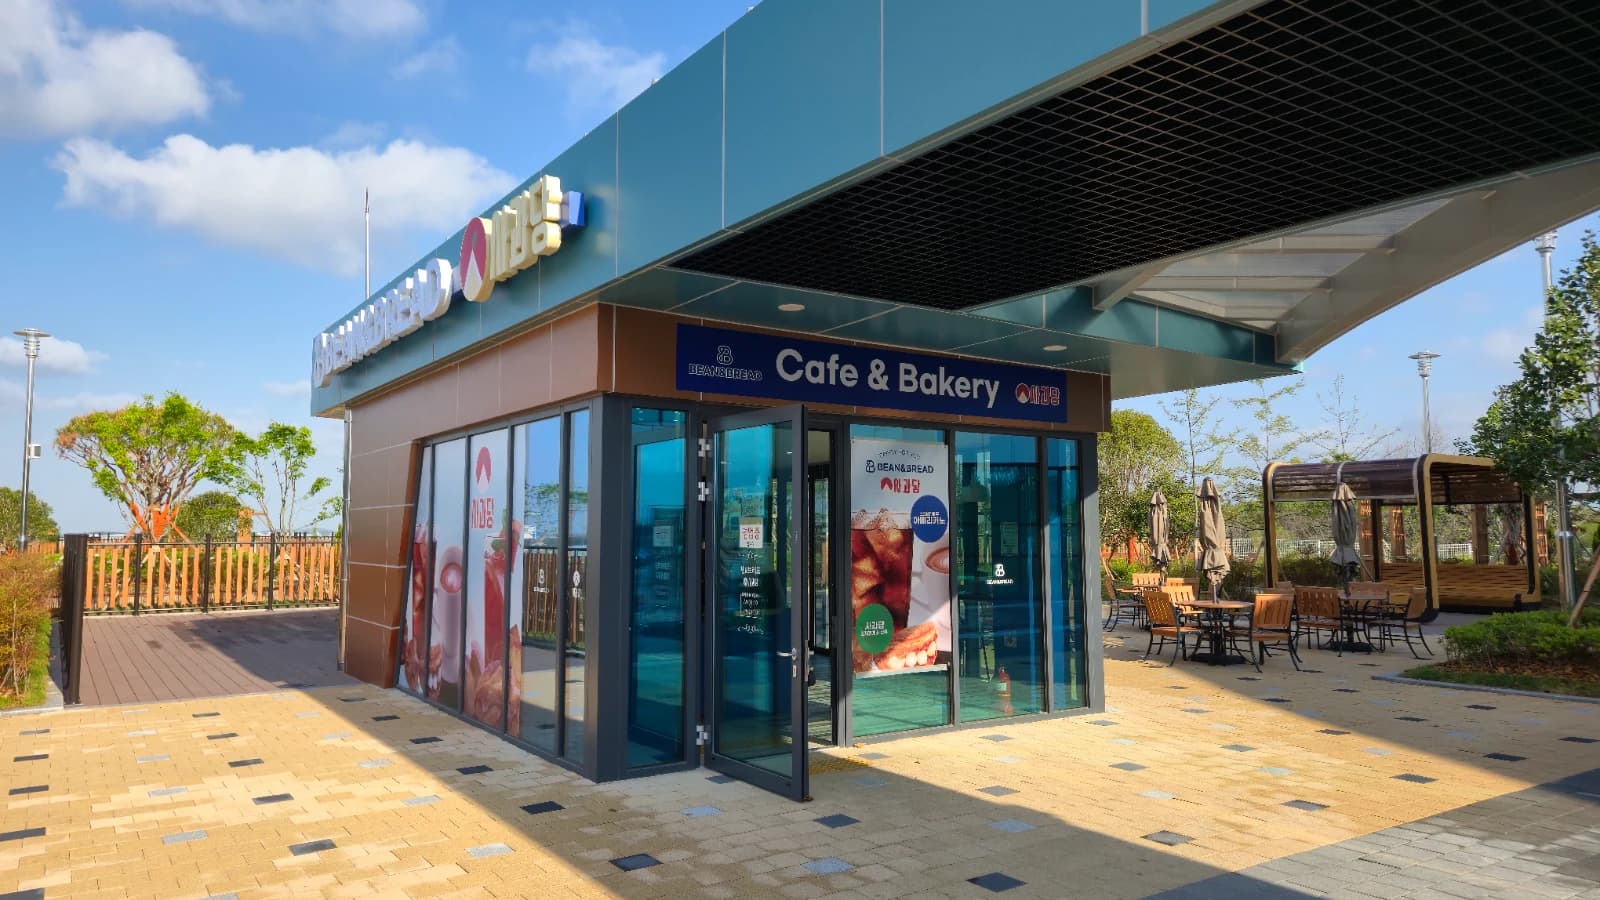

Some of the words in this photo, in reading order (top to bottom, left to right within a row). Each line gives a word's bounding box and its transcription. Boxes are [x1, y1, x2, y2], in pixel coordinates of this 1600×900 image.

[688, 363, 763, 381] BEAN&BREAD
[776, 348, 859, 388] Cafe
[867, 358, 889, 391] &
[898, 362, 1000, 409] Bakery
[877, 463, 934, 474] BEAN&BREAD
